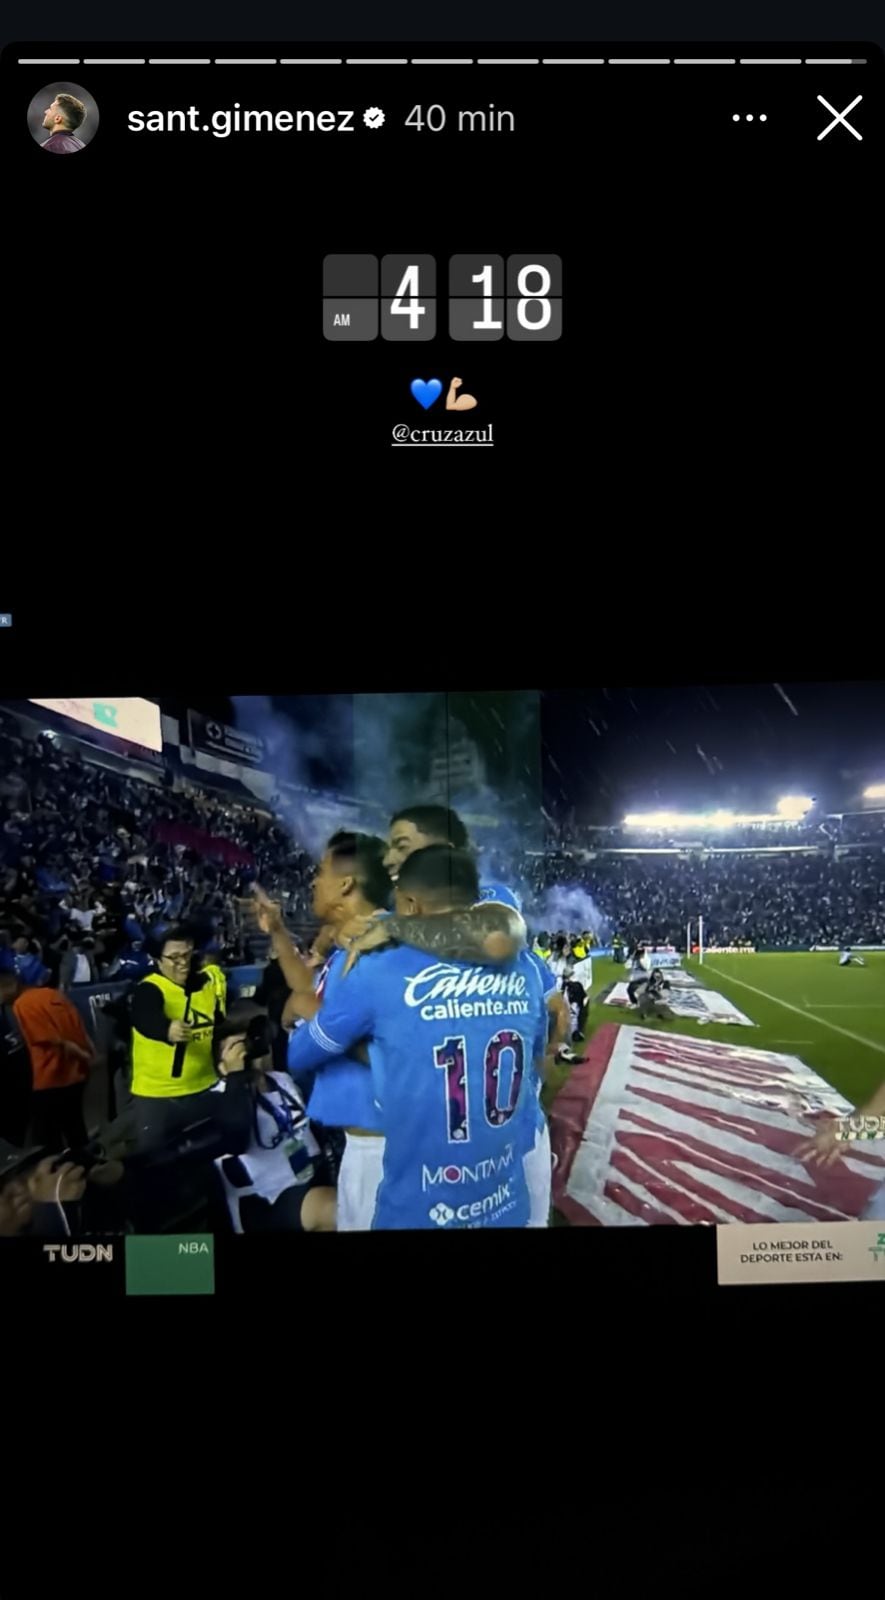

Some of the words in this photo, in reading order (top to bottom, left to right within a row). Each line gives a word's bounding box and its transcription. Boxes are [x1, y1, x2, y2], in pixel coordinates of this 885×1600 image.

[403, 962, 529, 1007] Caliente
[420, 998, 529, 1021] caliente.mx
[432, 1029, 525, 1144] 10
[456, 1183, 511, 1221] cemix
[43, 1243, 113, 1262] TUDN
[178, 1242, 209, 1255] NBA
[753, 1241, 767, 1251] LO
[770, 1241, 809, 1250] MEJOR
[812, 1240, 833, 1250] DEL
[740, 1253, 793, 1263] DEPORTE
[795, 1252, 823, 1262] ESTA
[826, 1252, 843, 1261] EN:
